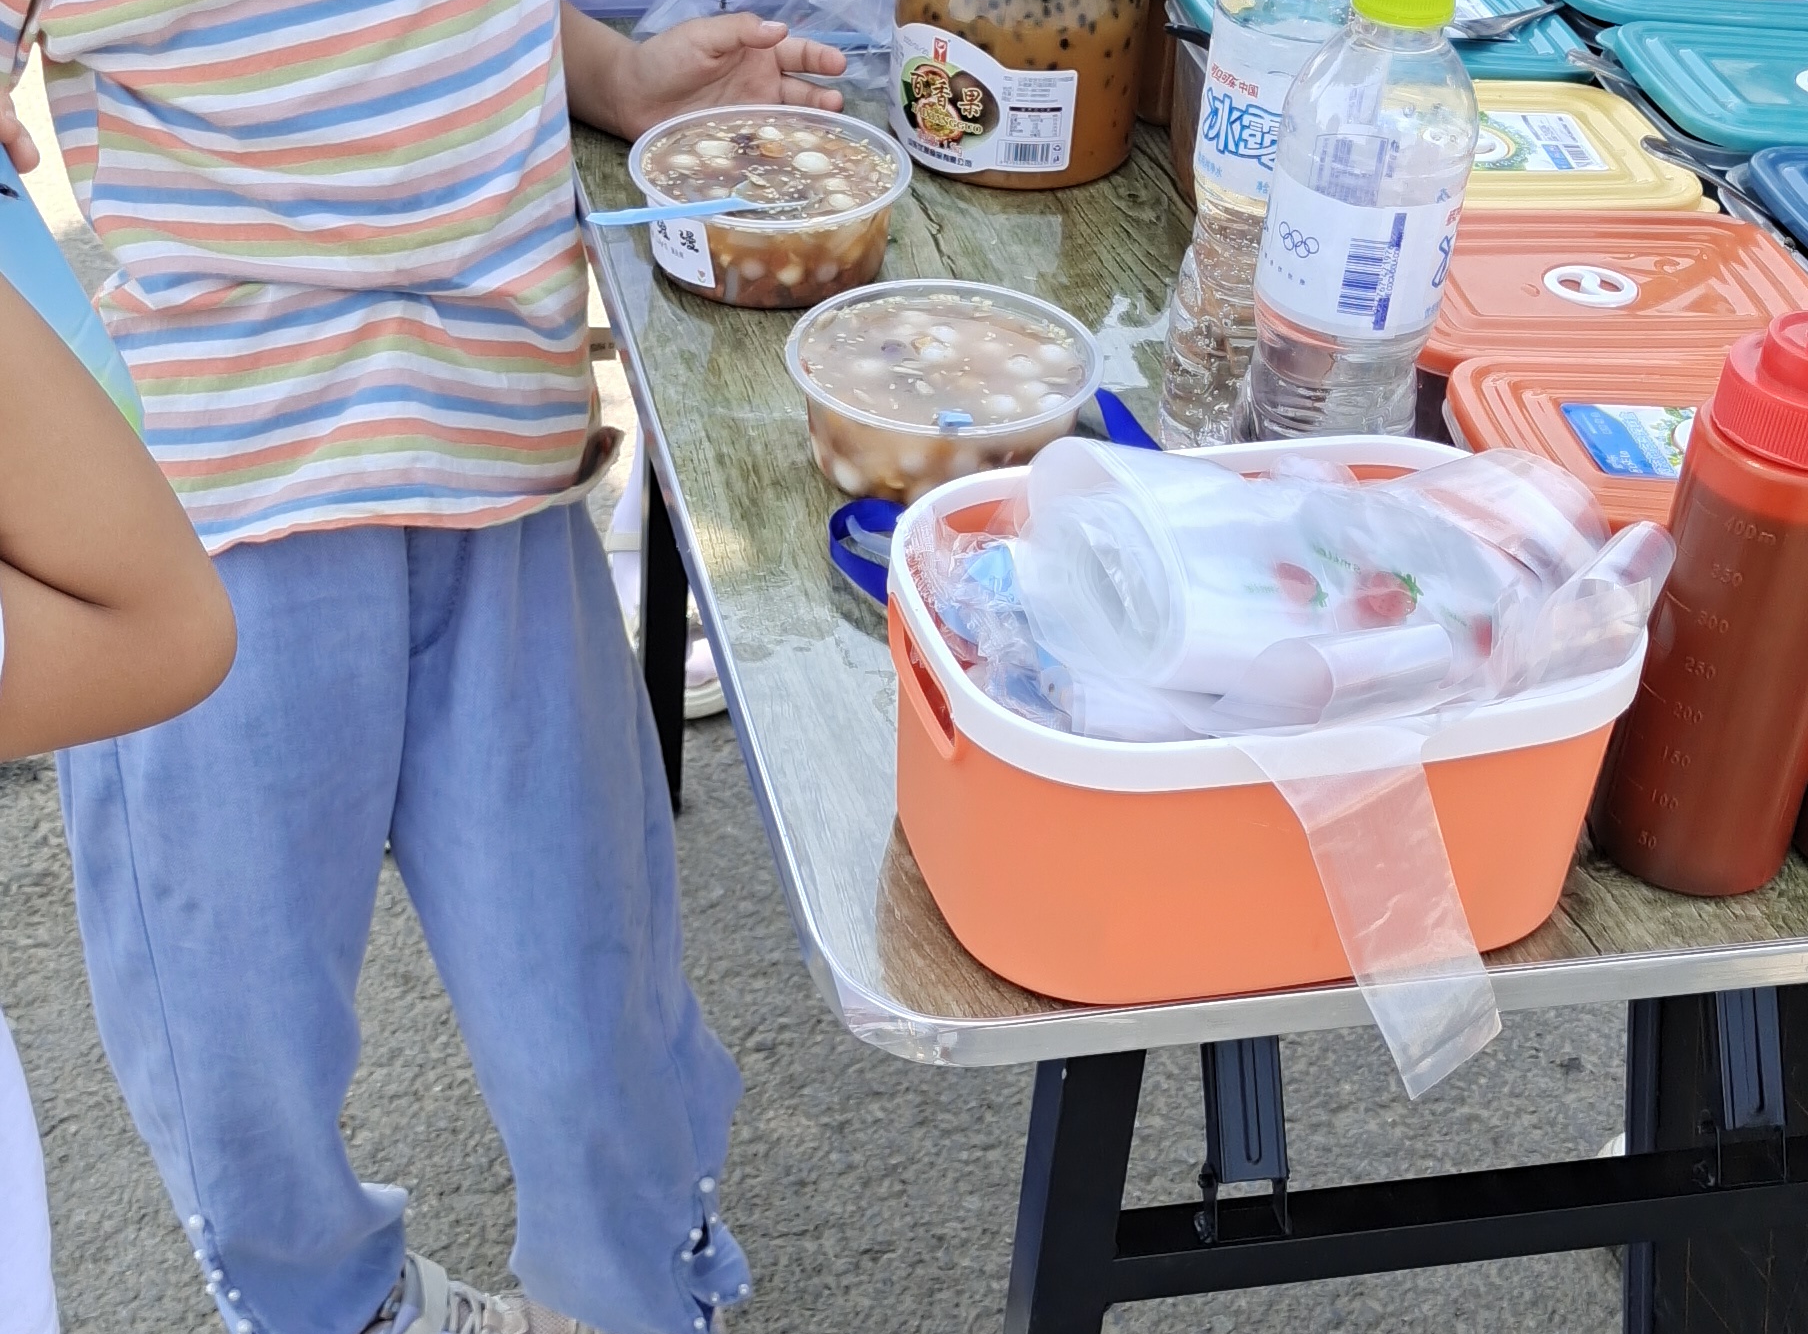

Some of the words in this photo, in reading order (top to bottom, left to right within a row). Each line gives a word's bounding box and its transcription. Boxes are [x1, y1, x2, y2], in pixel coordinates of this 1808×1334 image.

[909, 70, 985, 119] 百香果
[1238, 81, 1259, 98] 中国
[1202, 86, 1283, 171] 冰露
